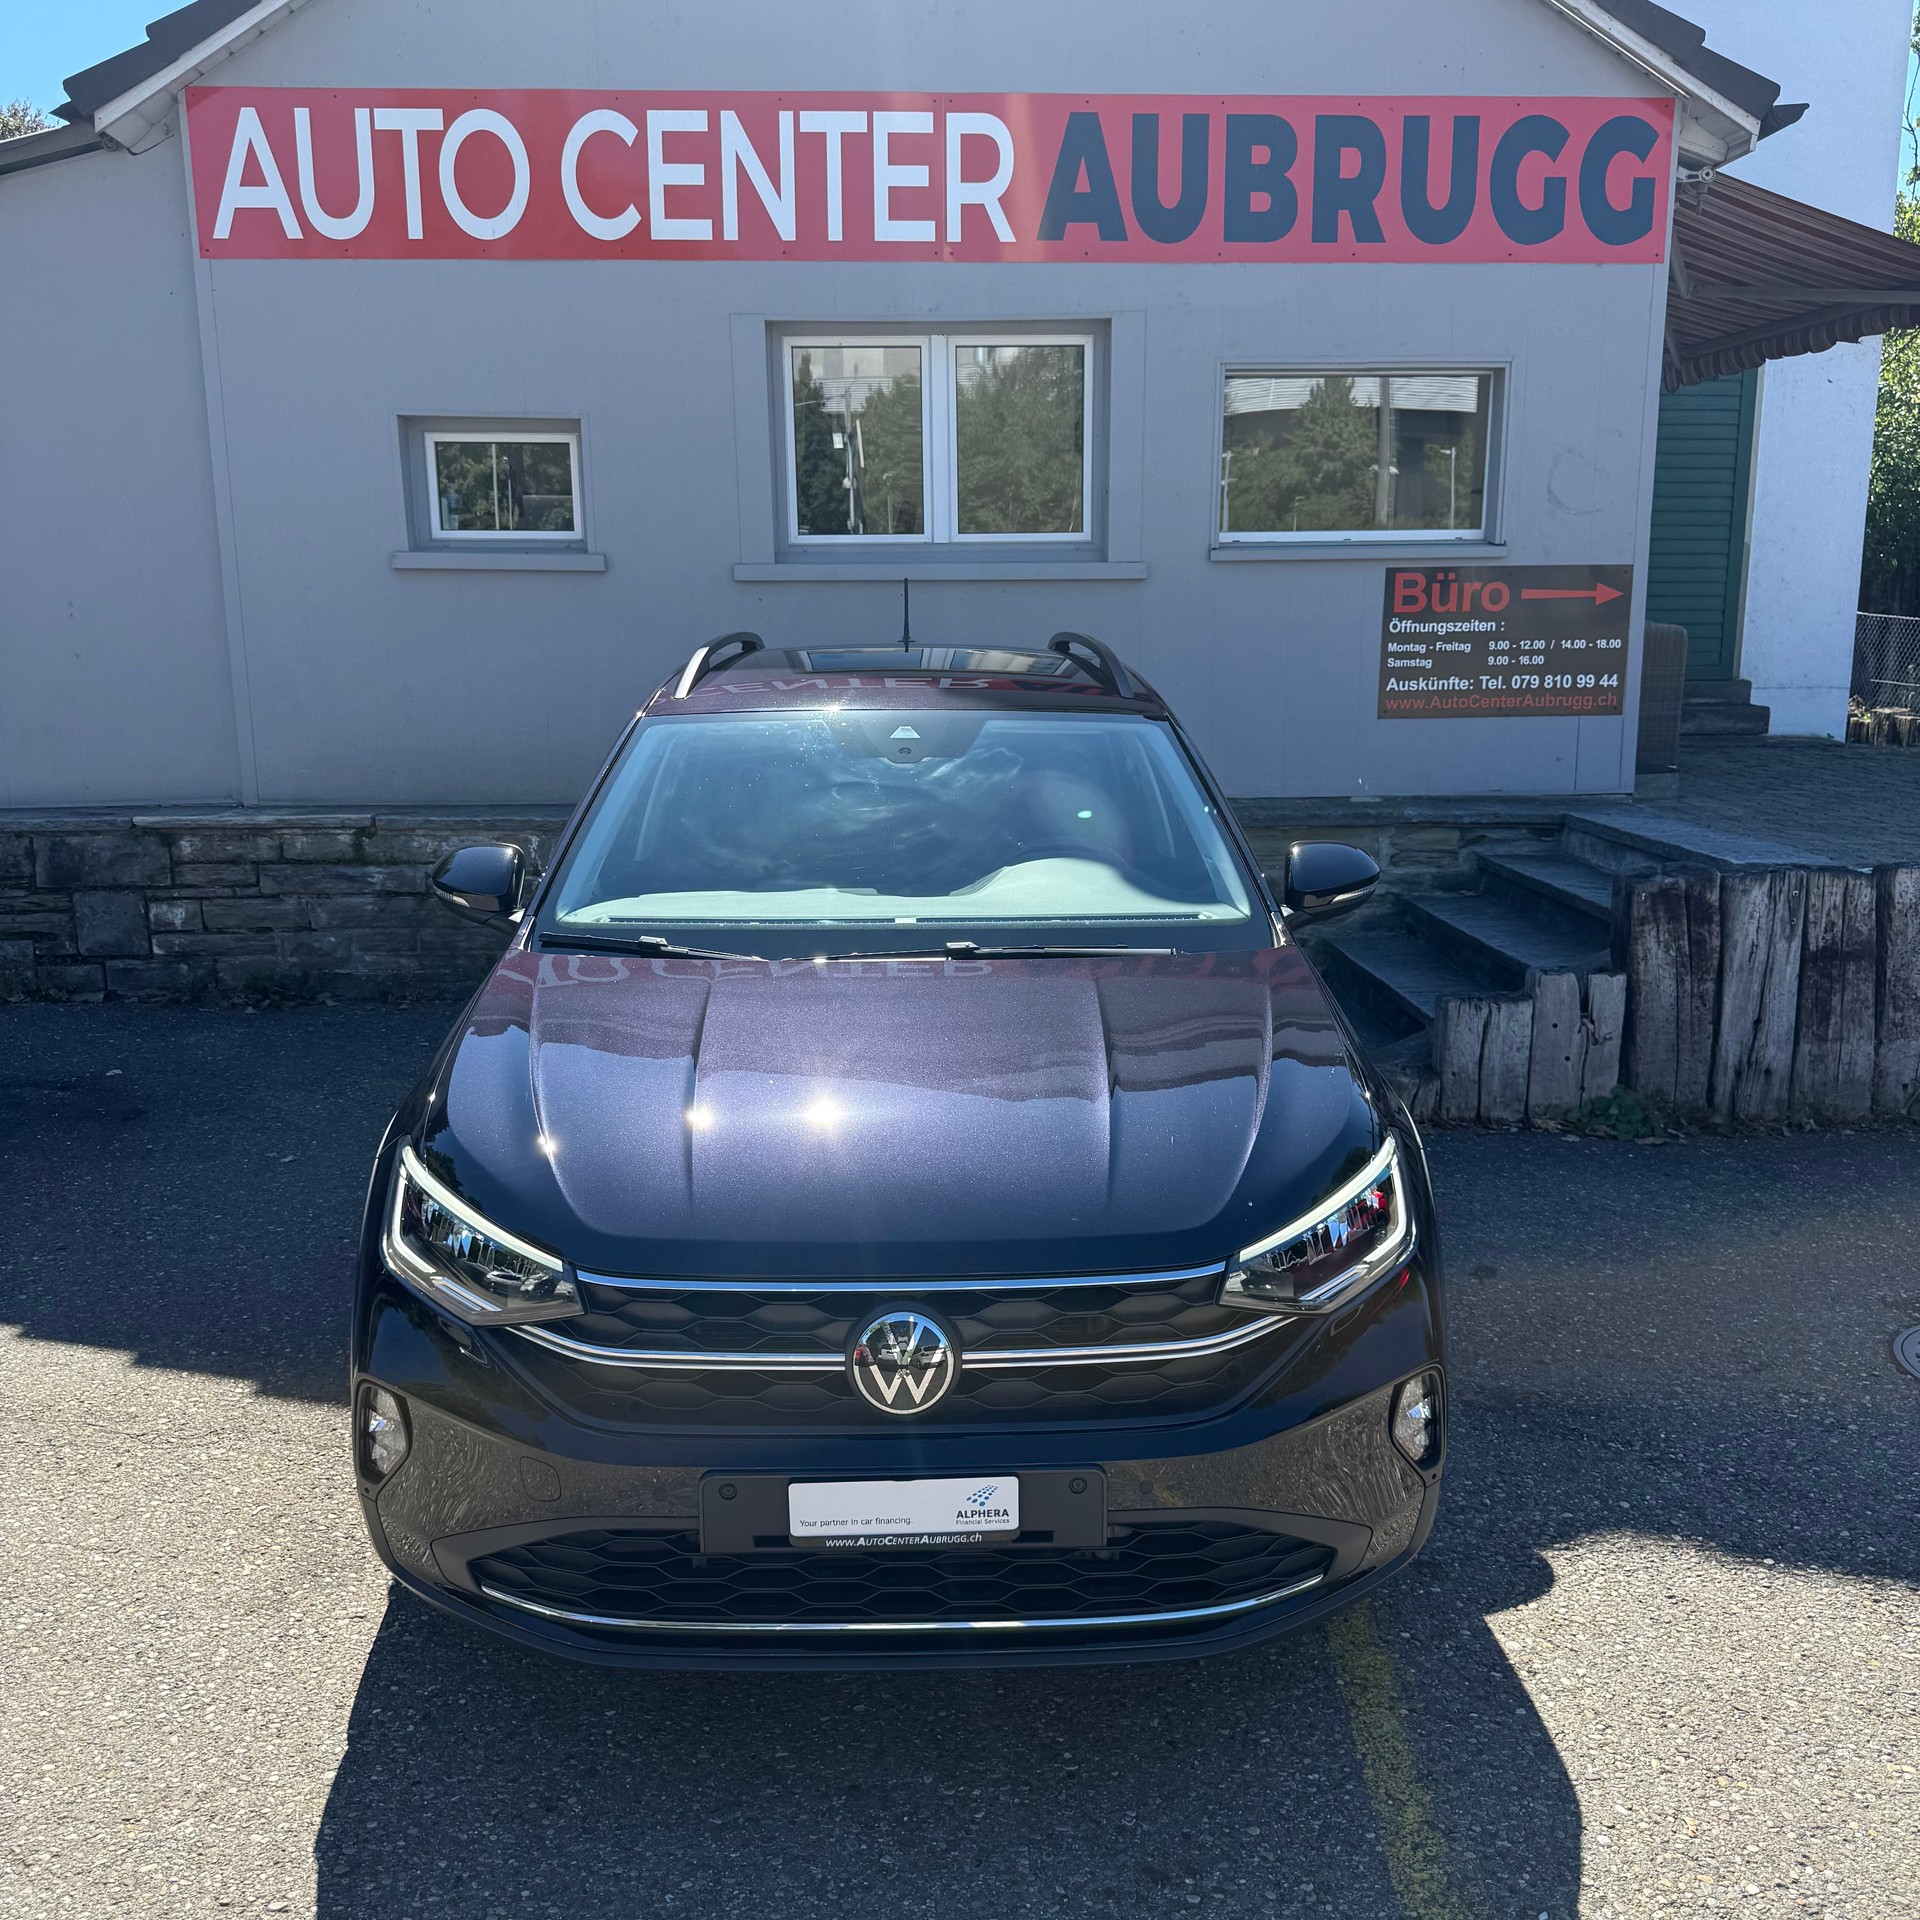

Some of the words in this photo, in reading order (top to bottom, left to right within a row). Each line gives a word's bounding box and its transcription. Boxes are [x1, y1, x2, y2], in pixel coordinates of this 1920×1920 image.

[212, 106, 531, 241] AUTO
[560, 108, 1016, 243] CENTER
[1036, 111, 1661, 246] AUBRUGG
[1393, 572, 1510, 614] Büro
[1388, 617, 1496, 635] Öffnungszeiten
[1387, 642, 1427, 654] Montag
[1435, 641, 1472, 653] Freitag
[1488, 640, 1510, 651] 9.00
[1519, 640, 1546, 650] 12.00
[1560, 639, 1586, 650] 14.00
[1595, 638, 1622, 650] 18.00
[1387, 657, 1433, 669] Samstag
[1487, 656, 1509, 666] 9.00
[1518, 655, 1545, 666] 16.00
[1386, 676, 1474, 692] Auskünfte:
[1480, 675, 1507, 690] Tel.
[1511, 675, 1540, 689] 079
[1543, 674, 1572, 689] 810
[1576, 674, 1595, 688] 99
[1599, 673, 1619, 688] 44
[1385, 692, 1617, 711] www.AutoCenterAubrugg.ch
[799, 1519, 818, 1527] Your
[820, 1518, 848, 1528] partner
[875, 1516, 913, 1526] financing.
[956, 1508, 1010, 1519] ALPHERA
